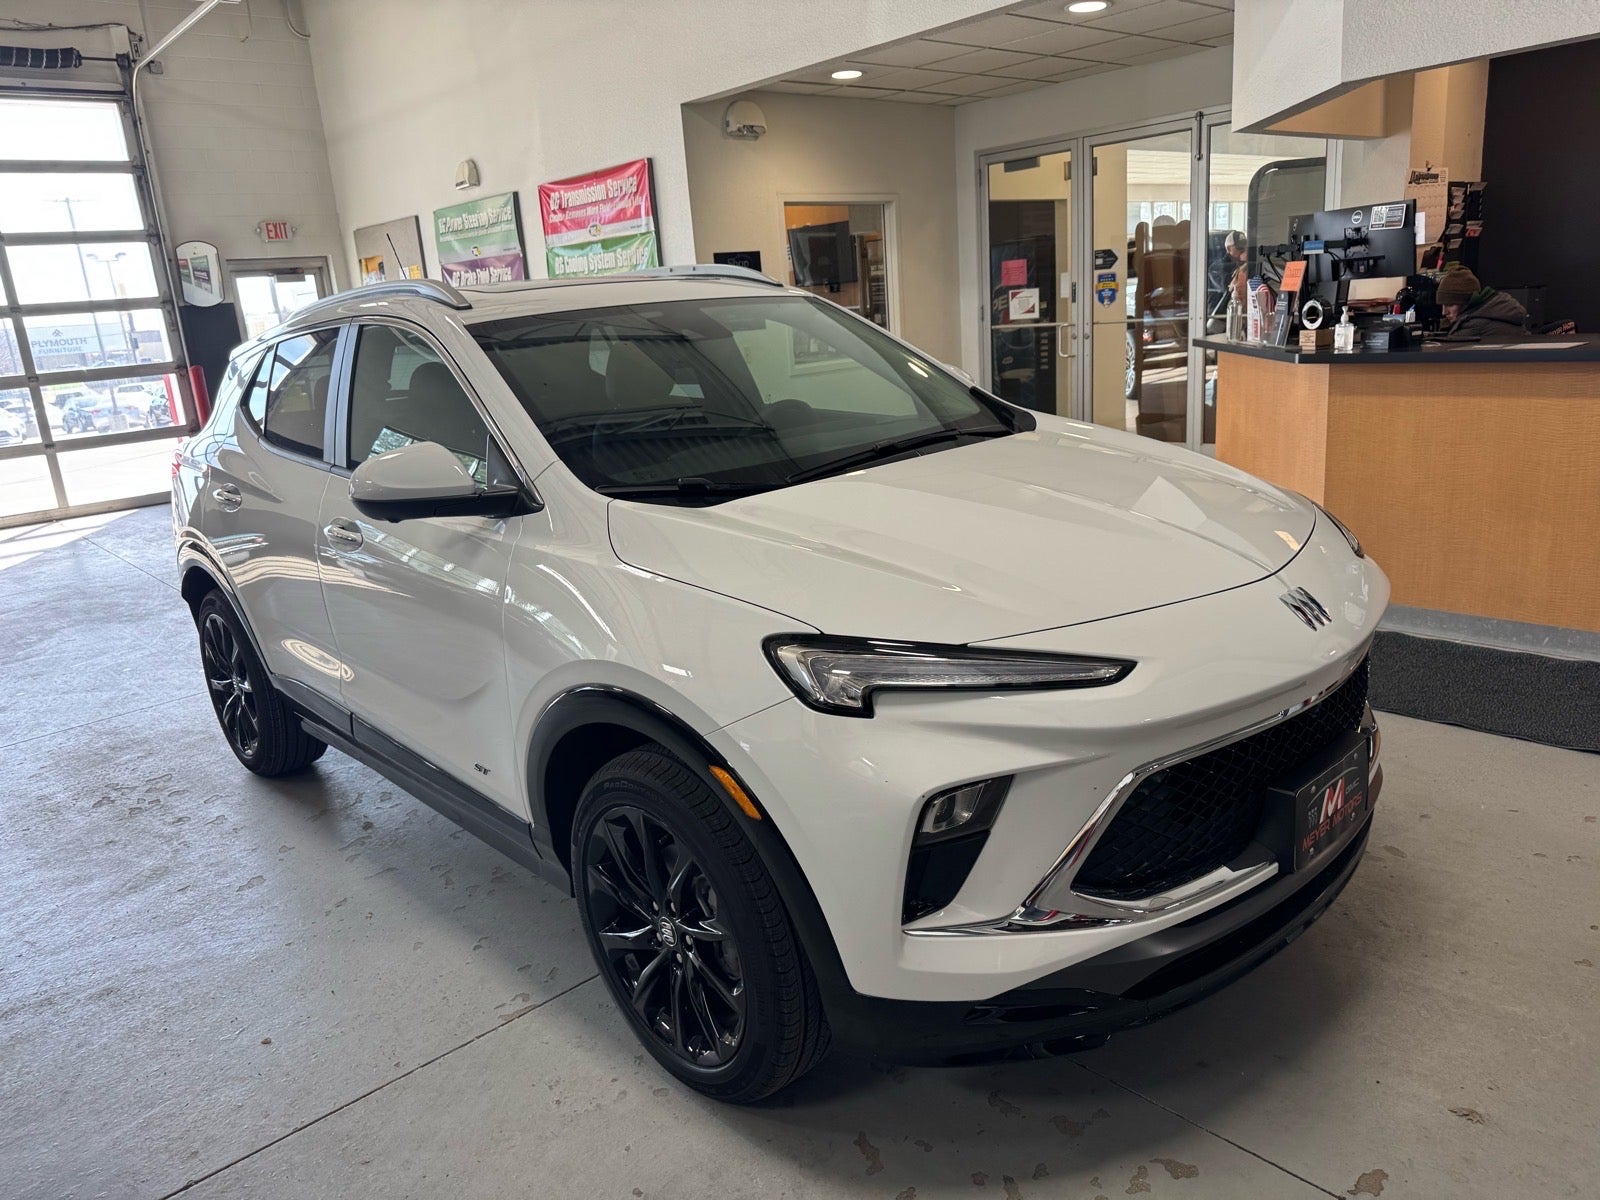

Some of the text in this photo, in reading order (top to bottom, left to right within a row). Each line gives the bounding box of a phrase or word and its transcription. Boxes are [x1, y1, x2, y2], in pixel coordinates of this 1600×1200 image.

[561, 183, 607, 209] Transmission
[607, 175, 638, 198] Service
[488, 206, 512, 225] Service
[265, 222, 288, 239] EXIT
[588, 252, 616, 274] System
[616, 247, 649, 267] Service
[489, 264, 512, 283] Service
[31, 337, 88, 348] PLYMOUTH
[1302, 791, 1362, 850] MEYER MOTORS
